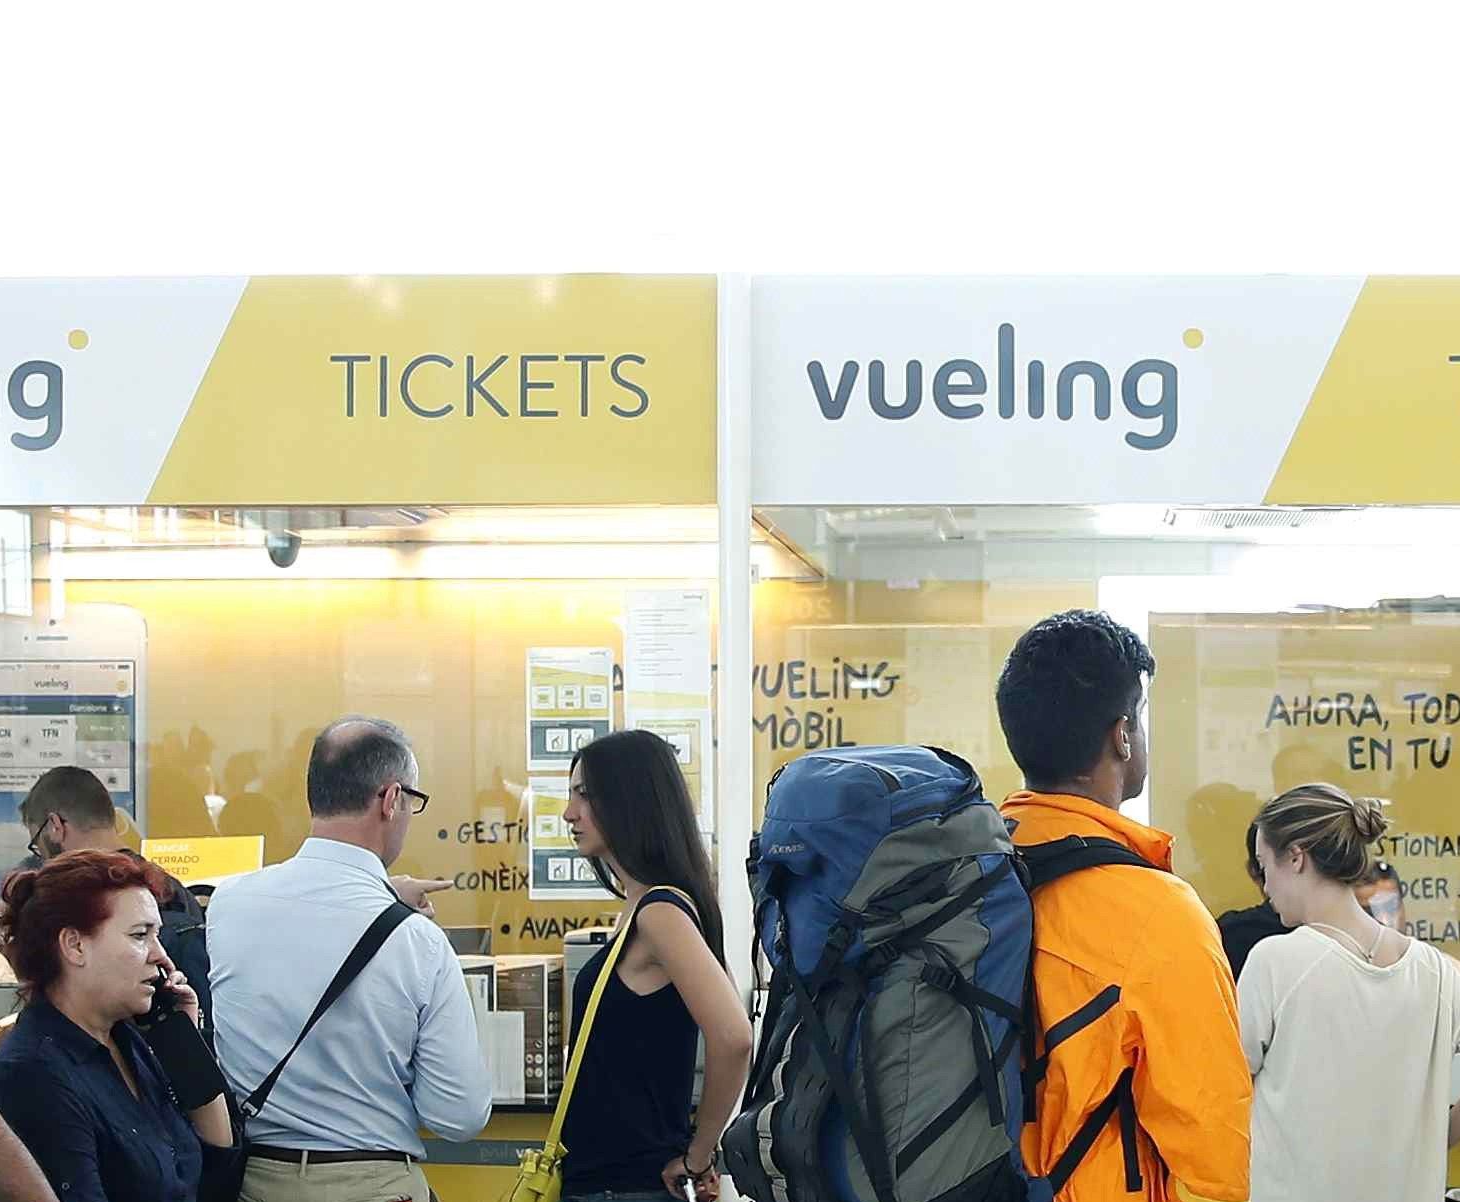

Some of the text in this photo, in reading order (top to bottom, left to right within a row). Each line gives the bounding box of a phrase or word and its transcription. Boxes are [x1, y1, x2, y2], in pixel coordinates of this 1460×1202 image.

[330, 354, 649, 418] TICKETS
[806, 323, 1178, 451] vueling
[1266, 692, 1390, 732] AHORA,
[1348, 736, 1392, 771] EN
[1406, 737, 1452, 770] TU
[150, 854, 200, 866] CERRADO
